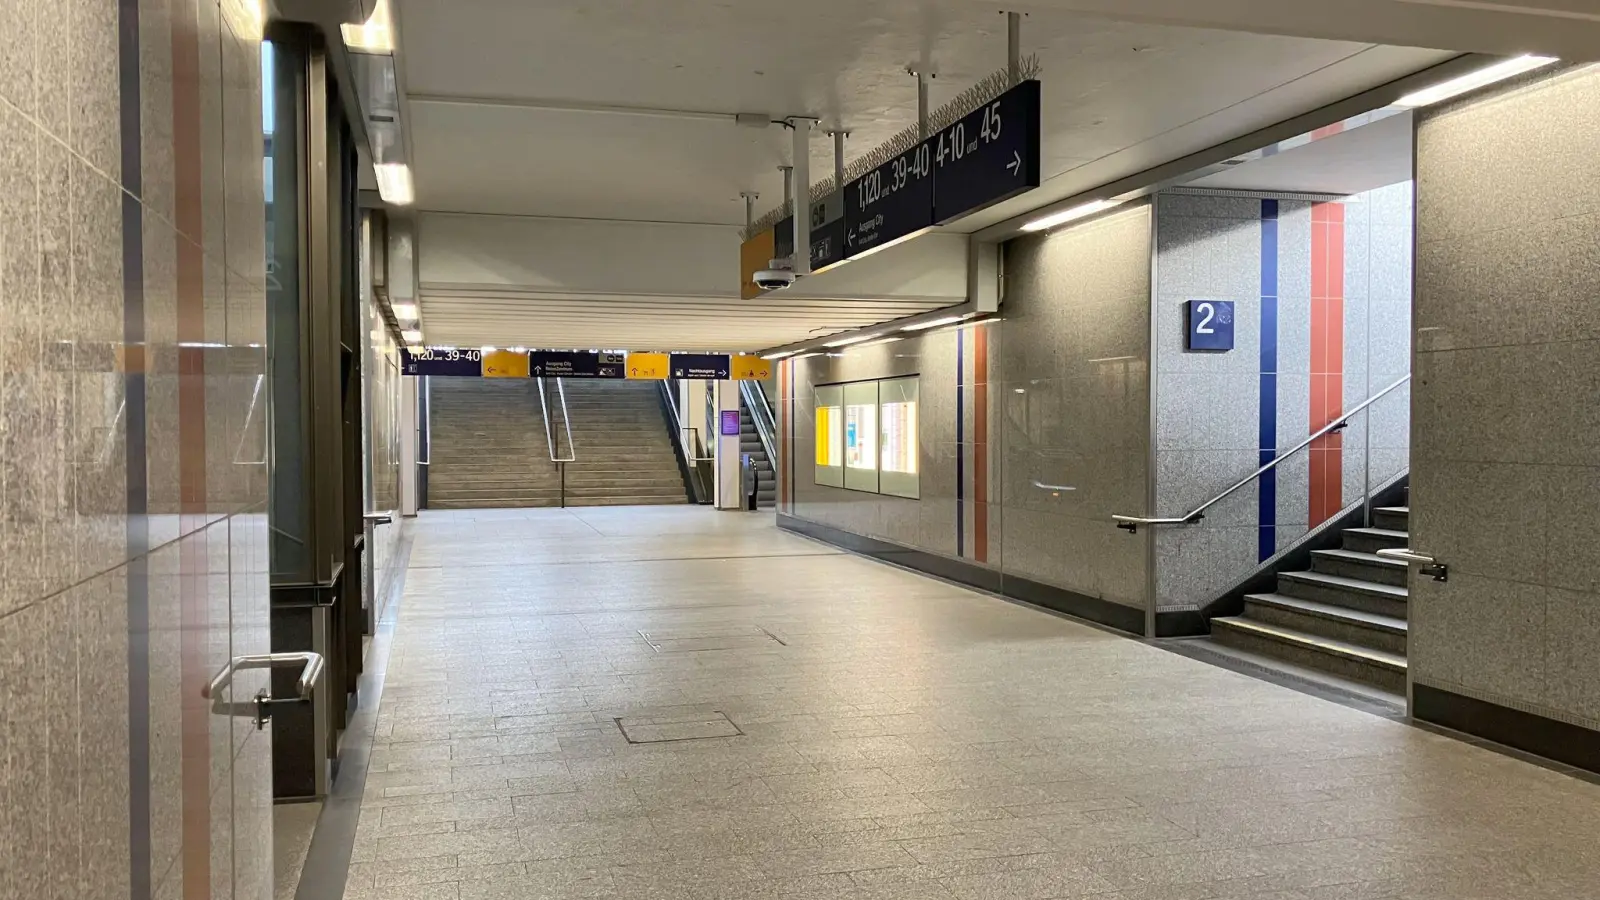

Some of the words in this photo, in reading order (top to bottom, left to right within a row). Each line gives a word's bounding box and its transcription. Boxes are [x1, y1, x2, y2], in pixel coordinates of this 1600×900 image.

[936, 122, 965, 168] 4-10
[966, 136, 978, 154] und
[980, 101, 1002, 143] 45
[891, 143, 930, 192] 39-40
[875, 213, 884, 226] City
[1196, 302, 1215, 334] 2
[445, 350, 480, 362] 39-40
